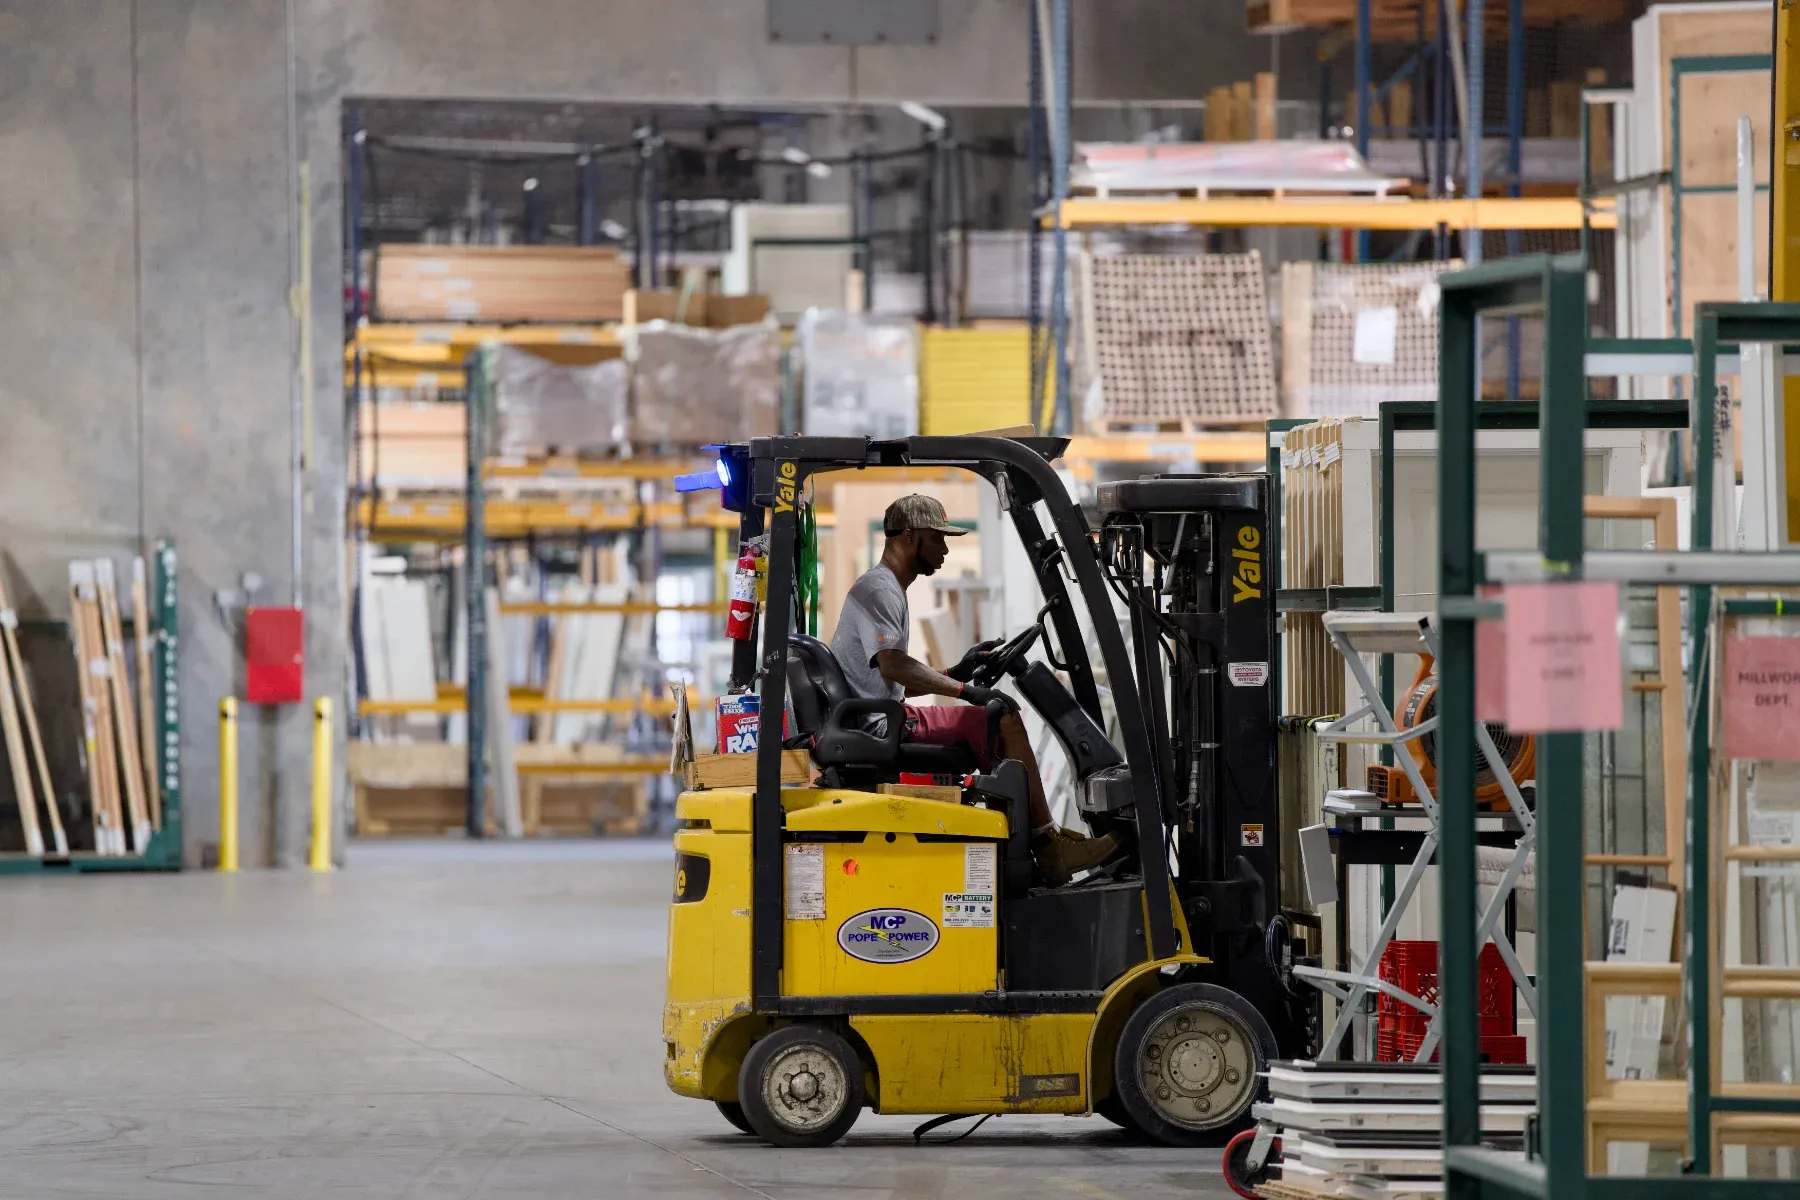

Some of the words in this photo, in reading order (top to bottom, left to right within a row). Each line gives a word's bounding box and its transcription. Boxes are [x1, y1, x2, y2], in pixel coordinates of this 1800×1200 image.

[775, 462, 797, 514] Yale
[1232, 525, 1261, 604] Yale
[848, 933, 879, 942] POPE
[888, 931, 929, 941] POWER
[870, 915, 906, 929] MCP
